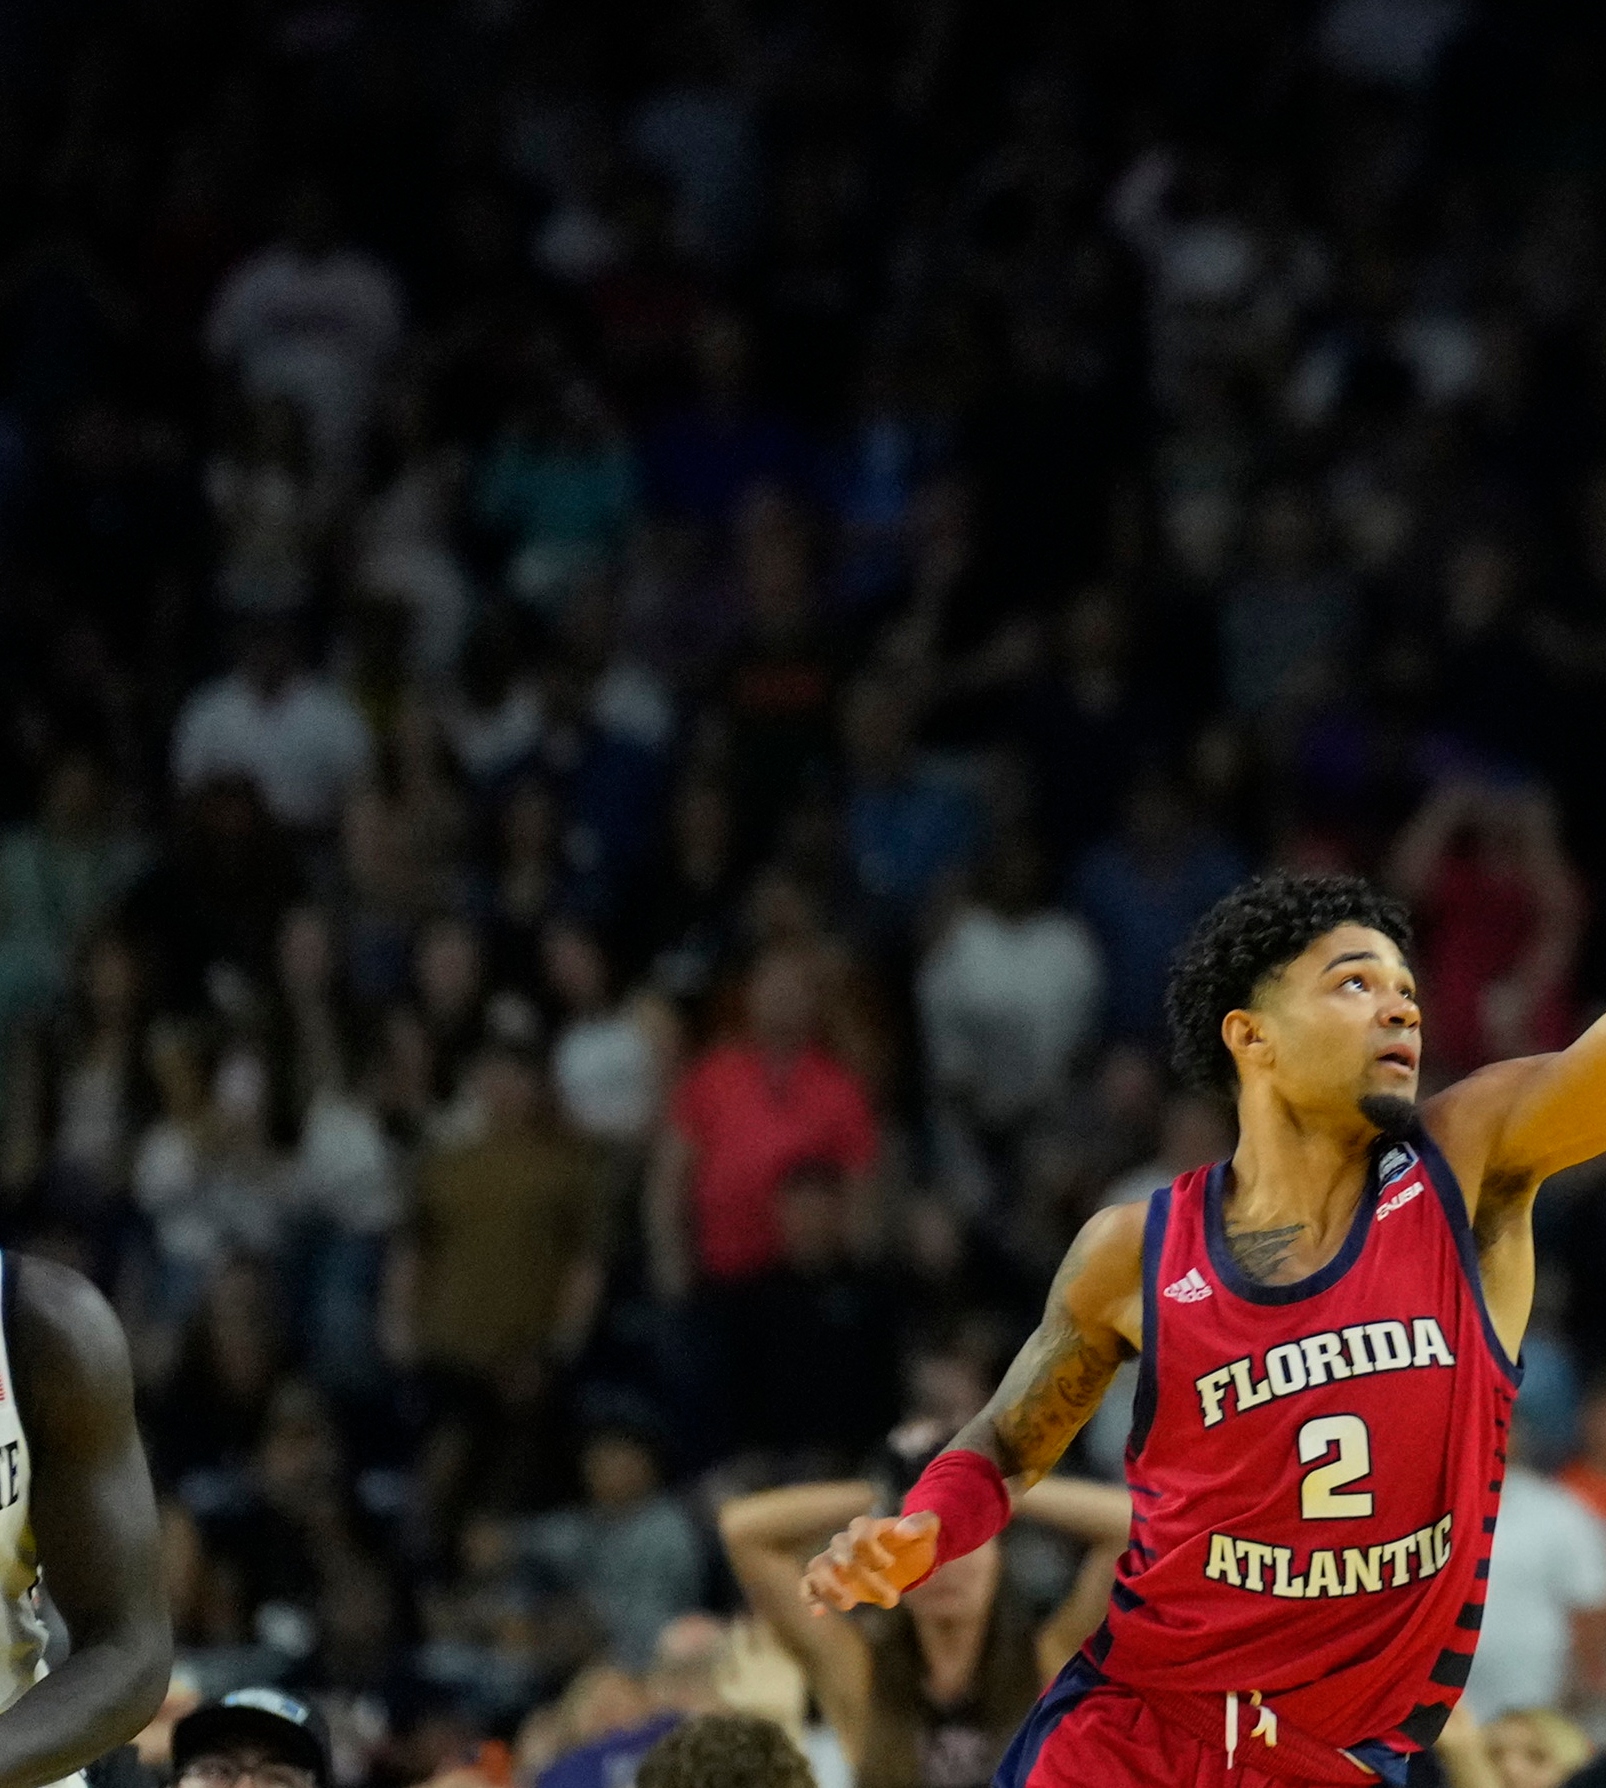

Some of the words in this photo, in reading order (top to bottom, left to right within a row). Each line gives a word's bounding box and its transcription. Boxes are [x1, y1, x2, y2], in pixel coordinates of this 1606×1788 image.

[1195, 1317, 1456, 1429] FLORIDA
[1297, 1412, 1375, 1520] 2
[1204, 1510, 1453, 1599] ATLANTIC
